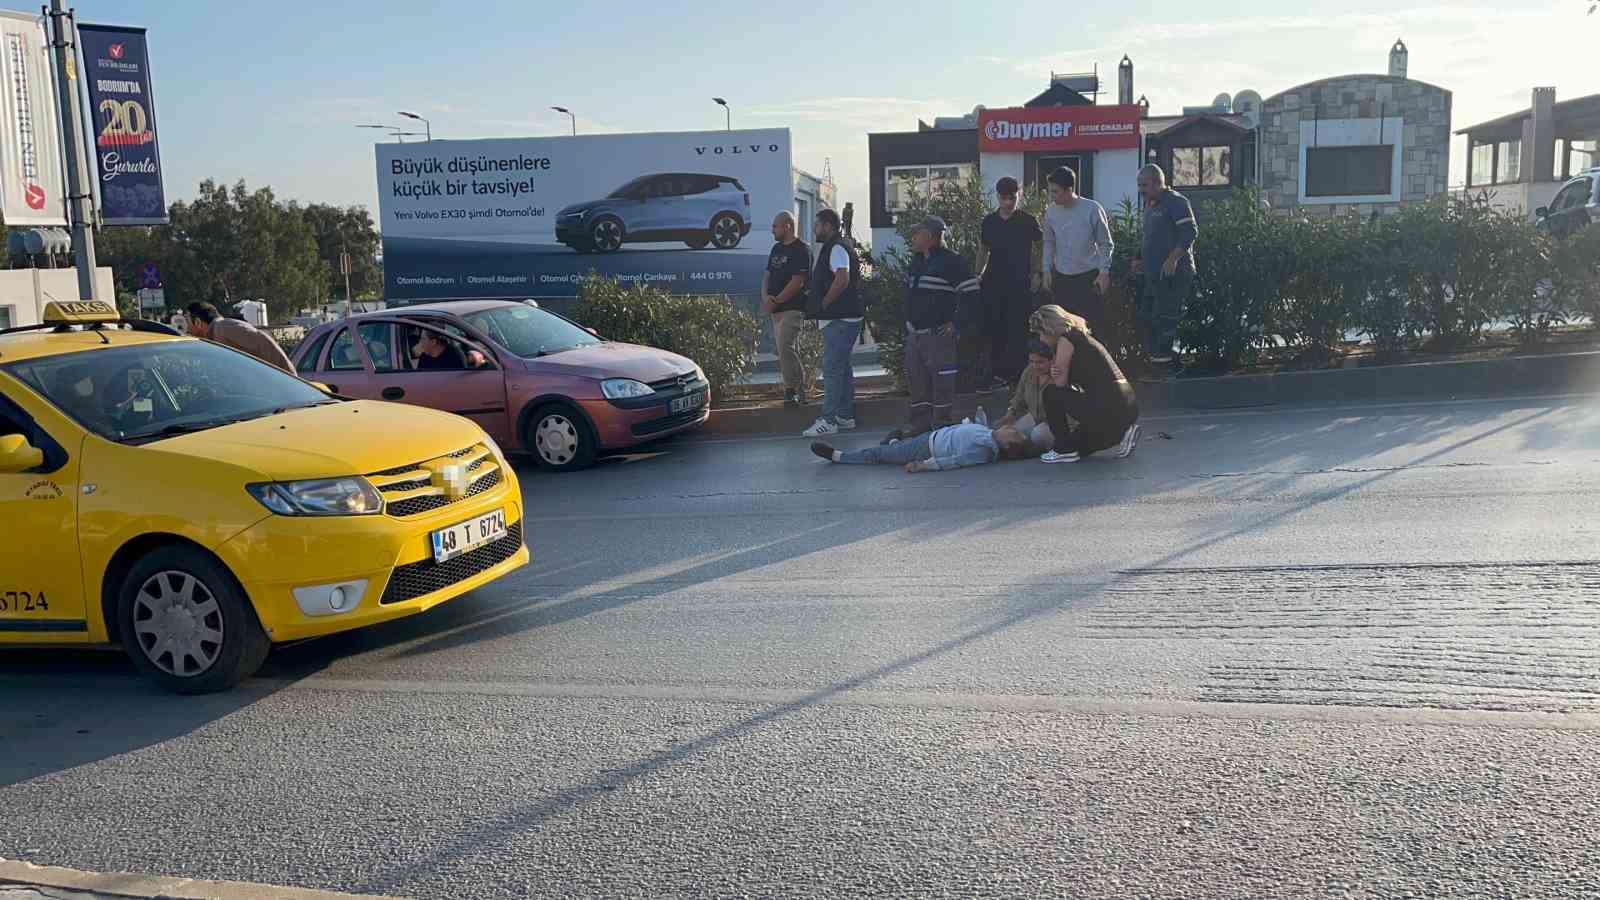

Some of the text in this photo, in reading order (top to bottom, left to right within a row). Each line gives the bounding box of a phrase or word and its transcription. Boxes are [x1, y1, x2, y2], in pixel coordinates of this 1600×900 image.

[99, 99, 147, 136] 20
[997, 121, 1072, 140] Duymer
[695, 144, 779, 155] VOLVO
[102, 151, 157, 181] Gururla
[391, 154, 551, 177] Büyük düşünenlere
[393, 177, 535, 200] küçük bir tavsiye!
[394, 210, 413, 220] Yeni
[414, 210, 439, 219] Volvo
[441, 209, 465, 219] EX30
[468, 208, 493, 219] şimdi
[397, 276, 455, 285] Otomol Bodrum
[467, 276, 496, 284] Otomol
[540, 274, 569, 283] Otomol
[690, 272, 707, 280] 444
[716, 271, 733, 280] 976
[442, 512, 503, 552] 48 T 6724
